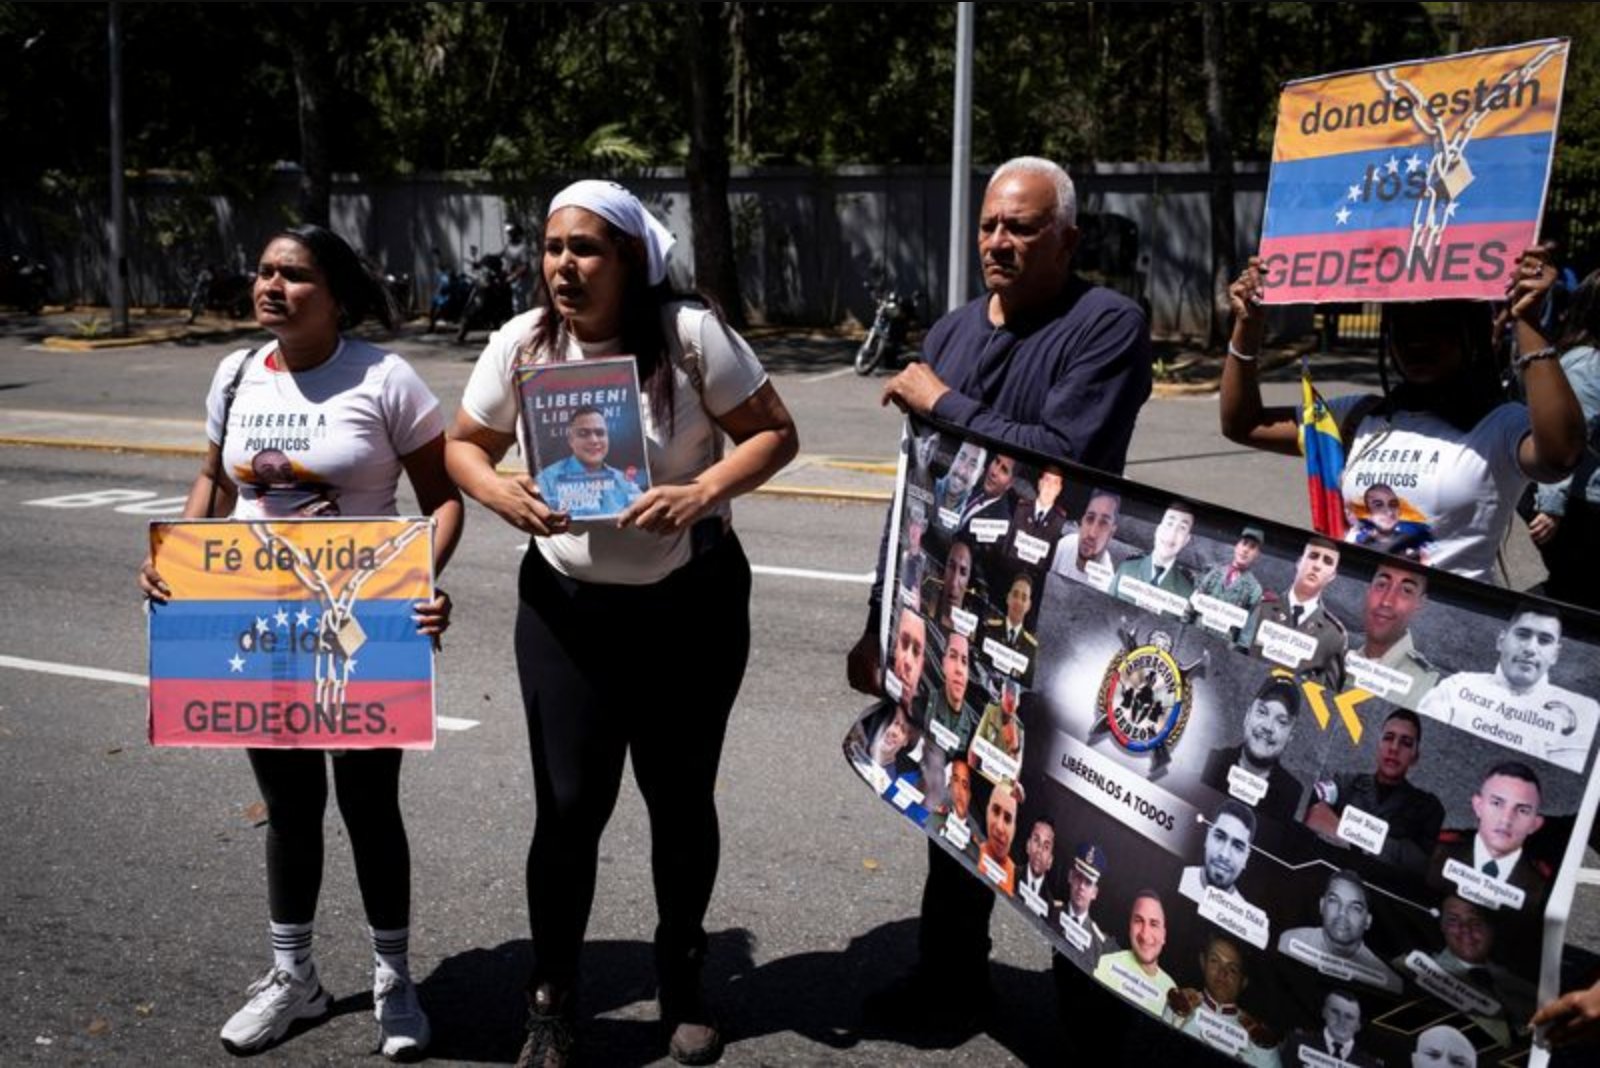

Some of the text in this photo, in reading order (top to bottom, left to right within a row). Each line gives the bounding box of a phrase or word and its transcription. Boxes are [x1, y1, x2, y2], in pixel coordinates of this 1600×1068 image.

[1300, 91, 1413, 136] donde
[1363, 163, 1427, 203] los
[241, 413, 327, 428] LIBEREN A
[542, 406, 621, 424] LIBN!
[1361, 449, 1439, 463] BEREN A
[203, 539, 377, 571] Fé de vida
[240, 622, 277, 653] de
[1459, 687, 1495, 709] Oscar
[183, 701, 397, 735] GEDEONES.
[1471, 717, 1523, 745] Gedeon
[1122, 791, 1132, 807] A
[1134, 796, 1175, 831] TODOS
